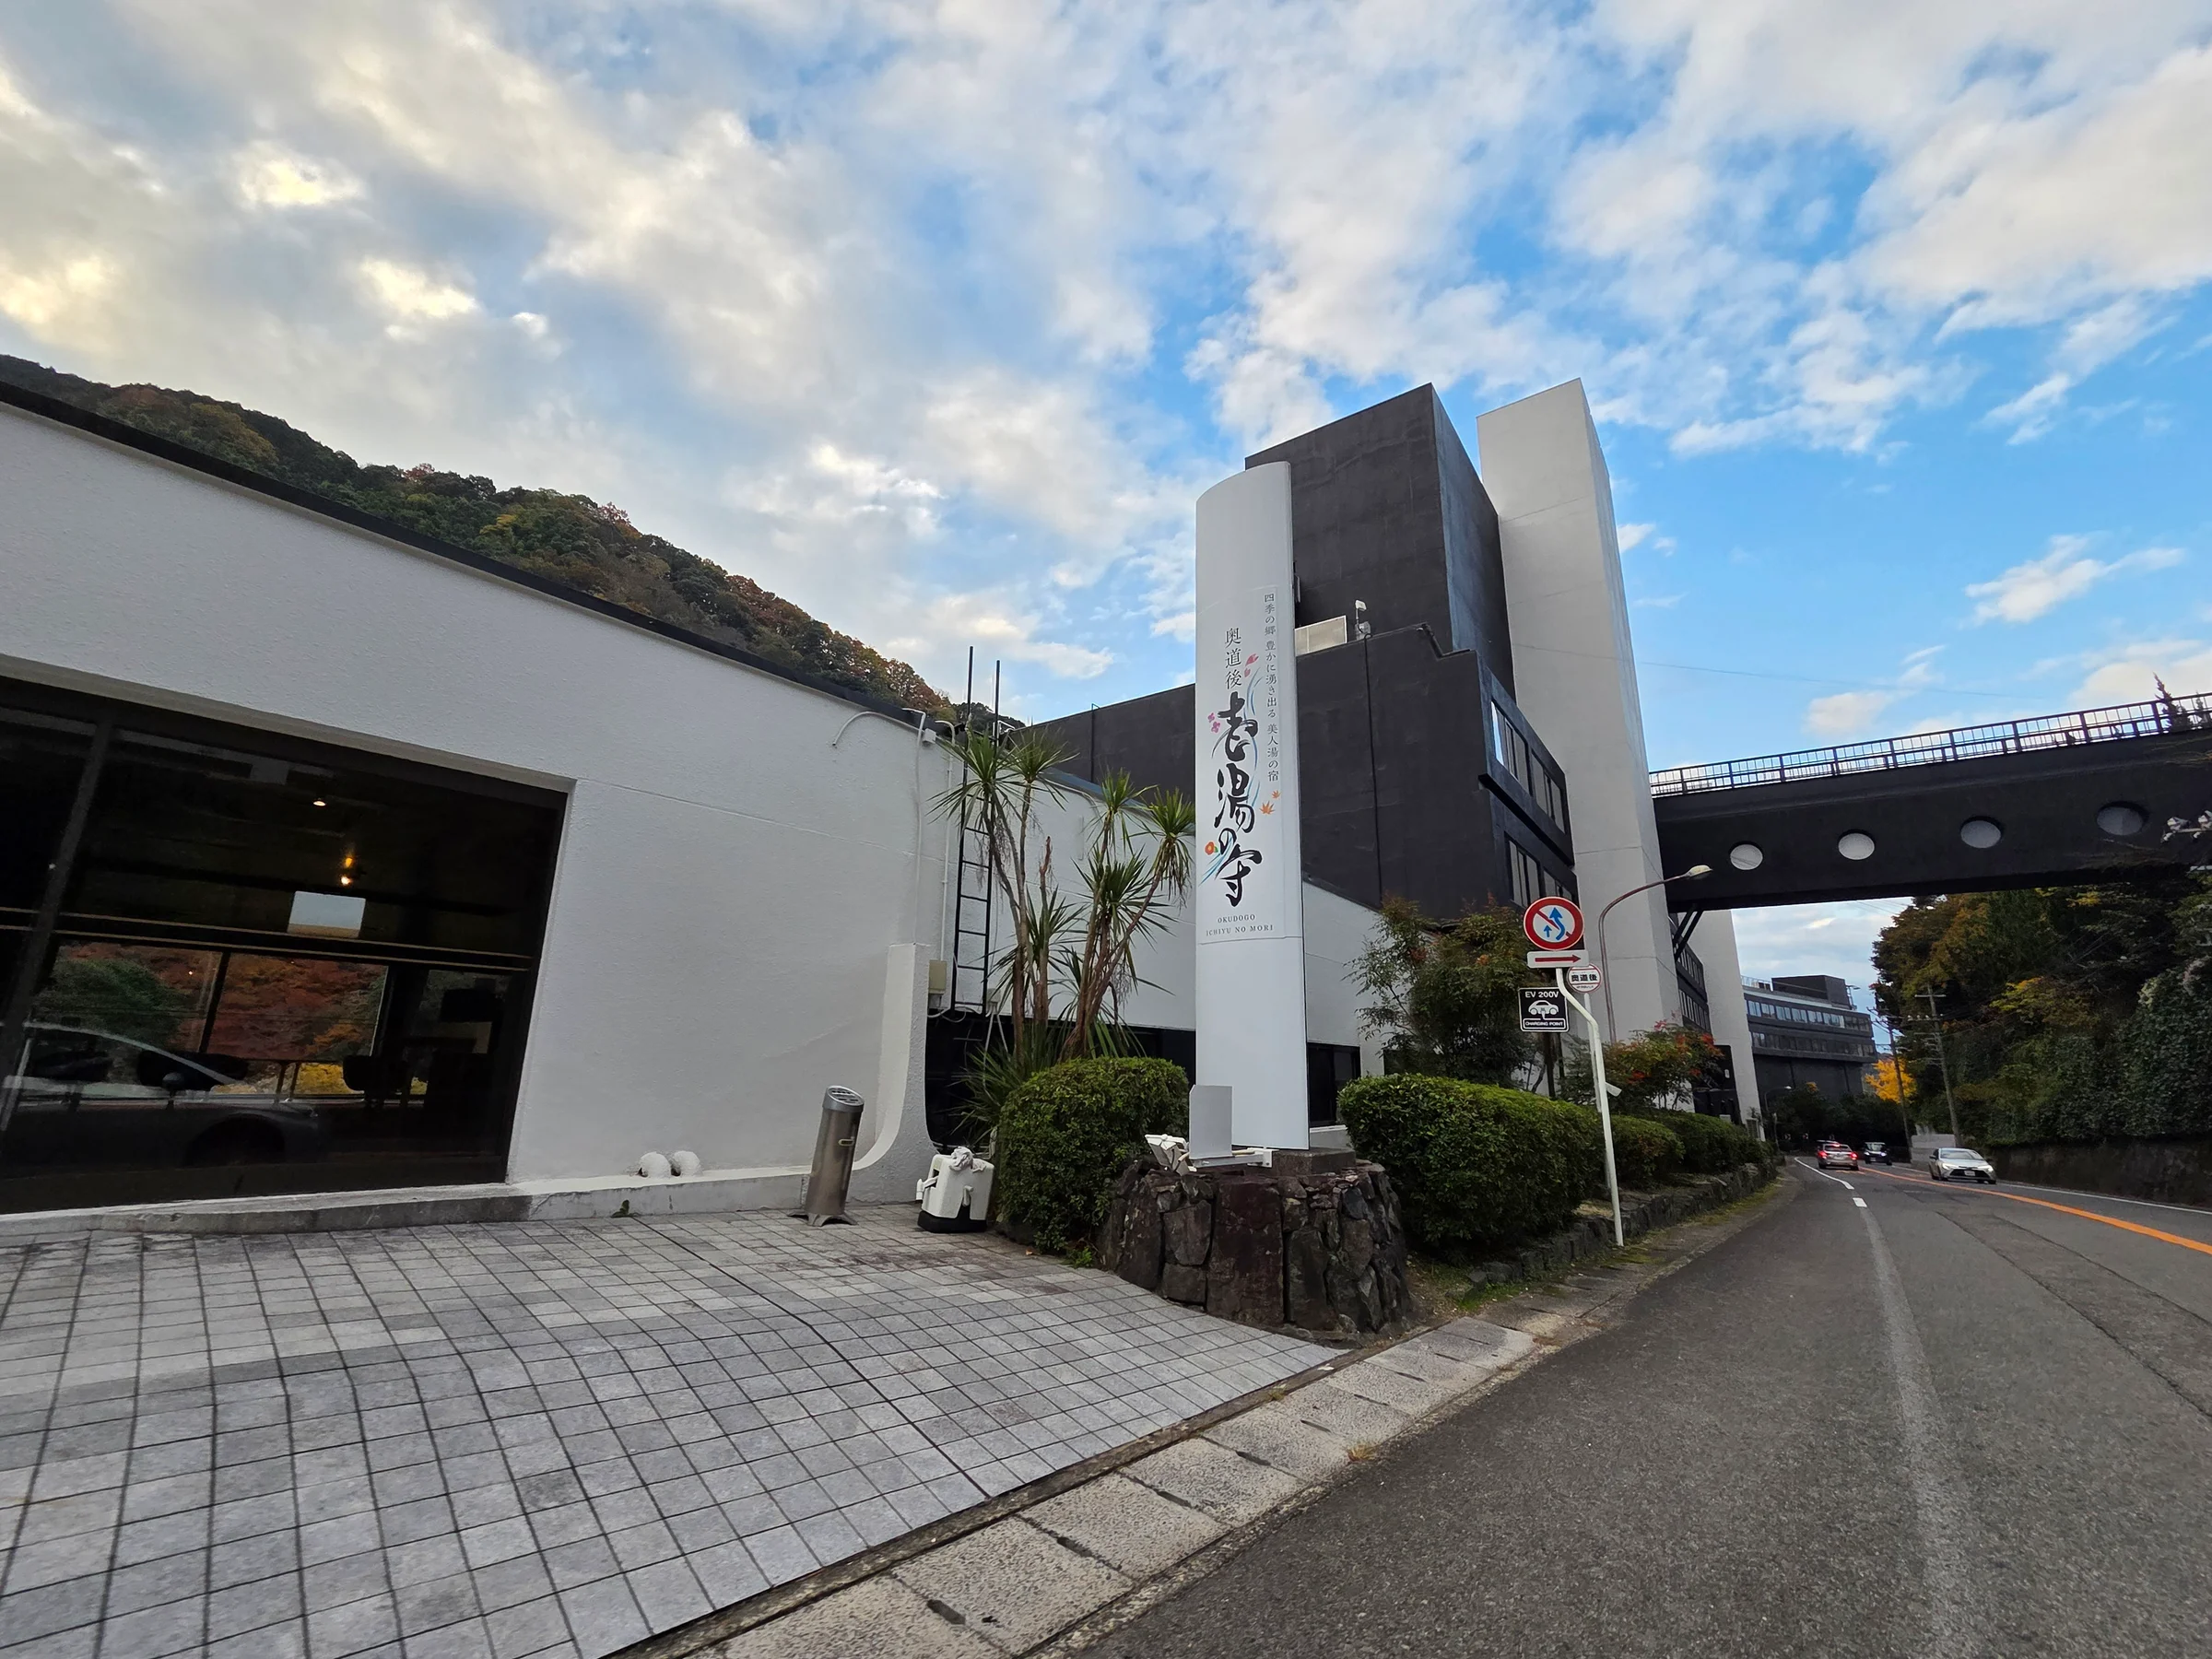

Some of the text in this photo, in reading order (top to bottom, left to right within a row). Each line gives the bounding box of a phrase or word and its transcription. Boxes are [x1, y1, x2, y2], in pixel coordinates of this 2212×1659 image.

[1264, 593, 1277, 636] 四季の郷
[1224, 628, 1242, 691] 奥道後
[1266, 724, 1279, 782] 美人湯の宿
[1206, 927, 1231, 936] ICHIYU
[1218, 914, 1255, 924] OKUDOGO
